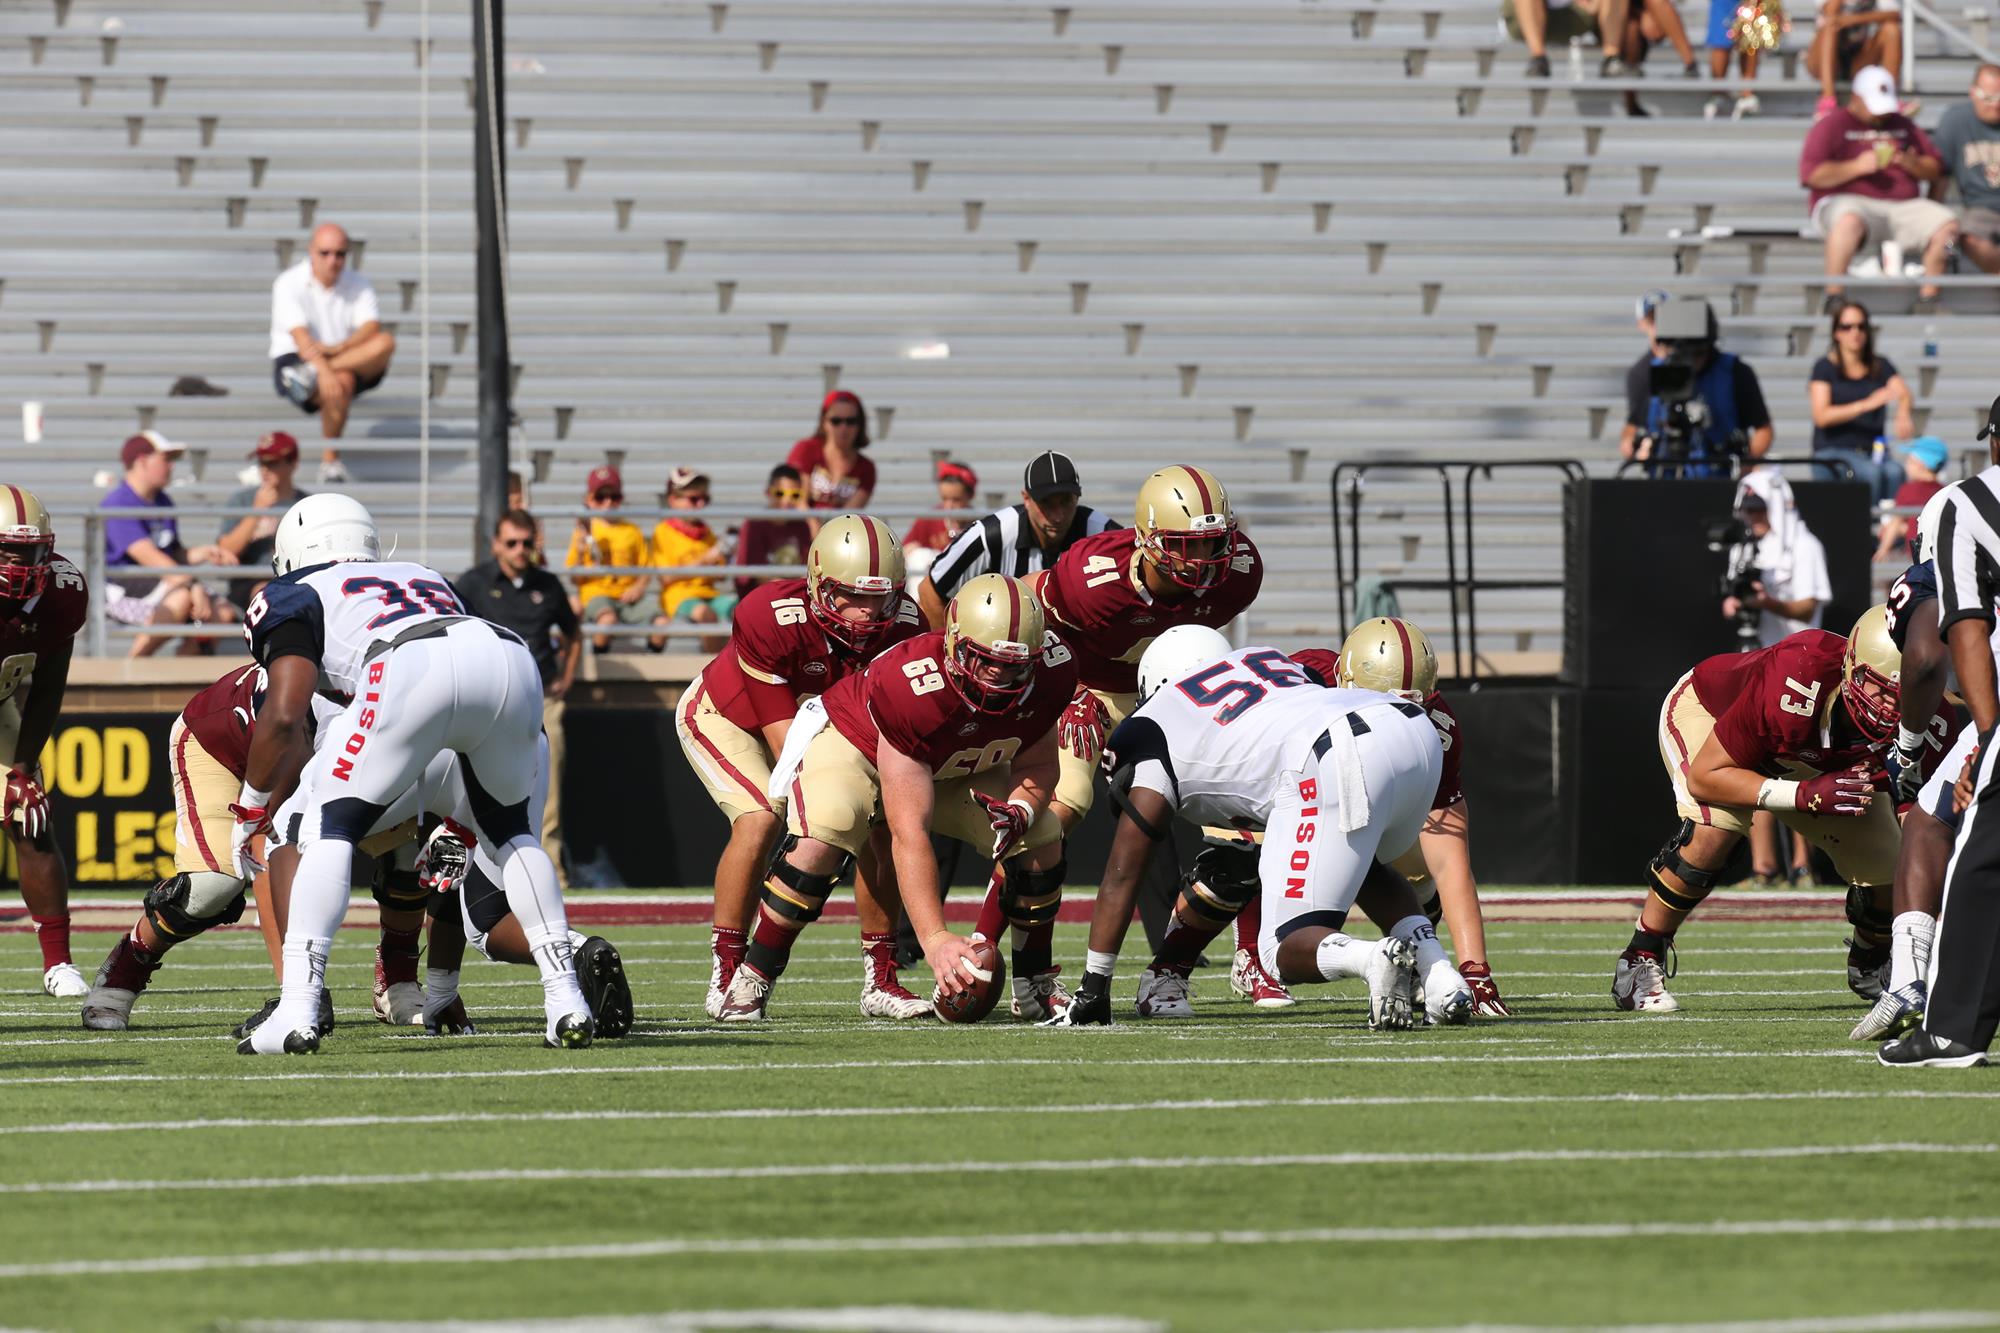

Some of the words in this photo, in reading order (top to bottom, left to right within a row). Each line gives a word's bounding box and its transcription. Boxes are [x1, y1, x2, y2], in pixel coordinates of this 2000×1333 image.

[50, 560, 84, 592] 38
[1083, 556, 1120, 588] 41
[770, 597, 808, 626] 16
[1042, 630, 1072, 668] 69
[0, 652, 37, 701] 8
[901, 657, 946, 697] 69
[1174, 649, 1312, 727] 56
[1780, 676, 1822, 717] 73
[331, 661, 385, 782] BISON
[1284, 777, 1319, 899] BISON
